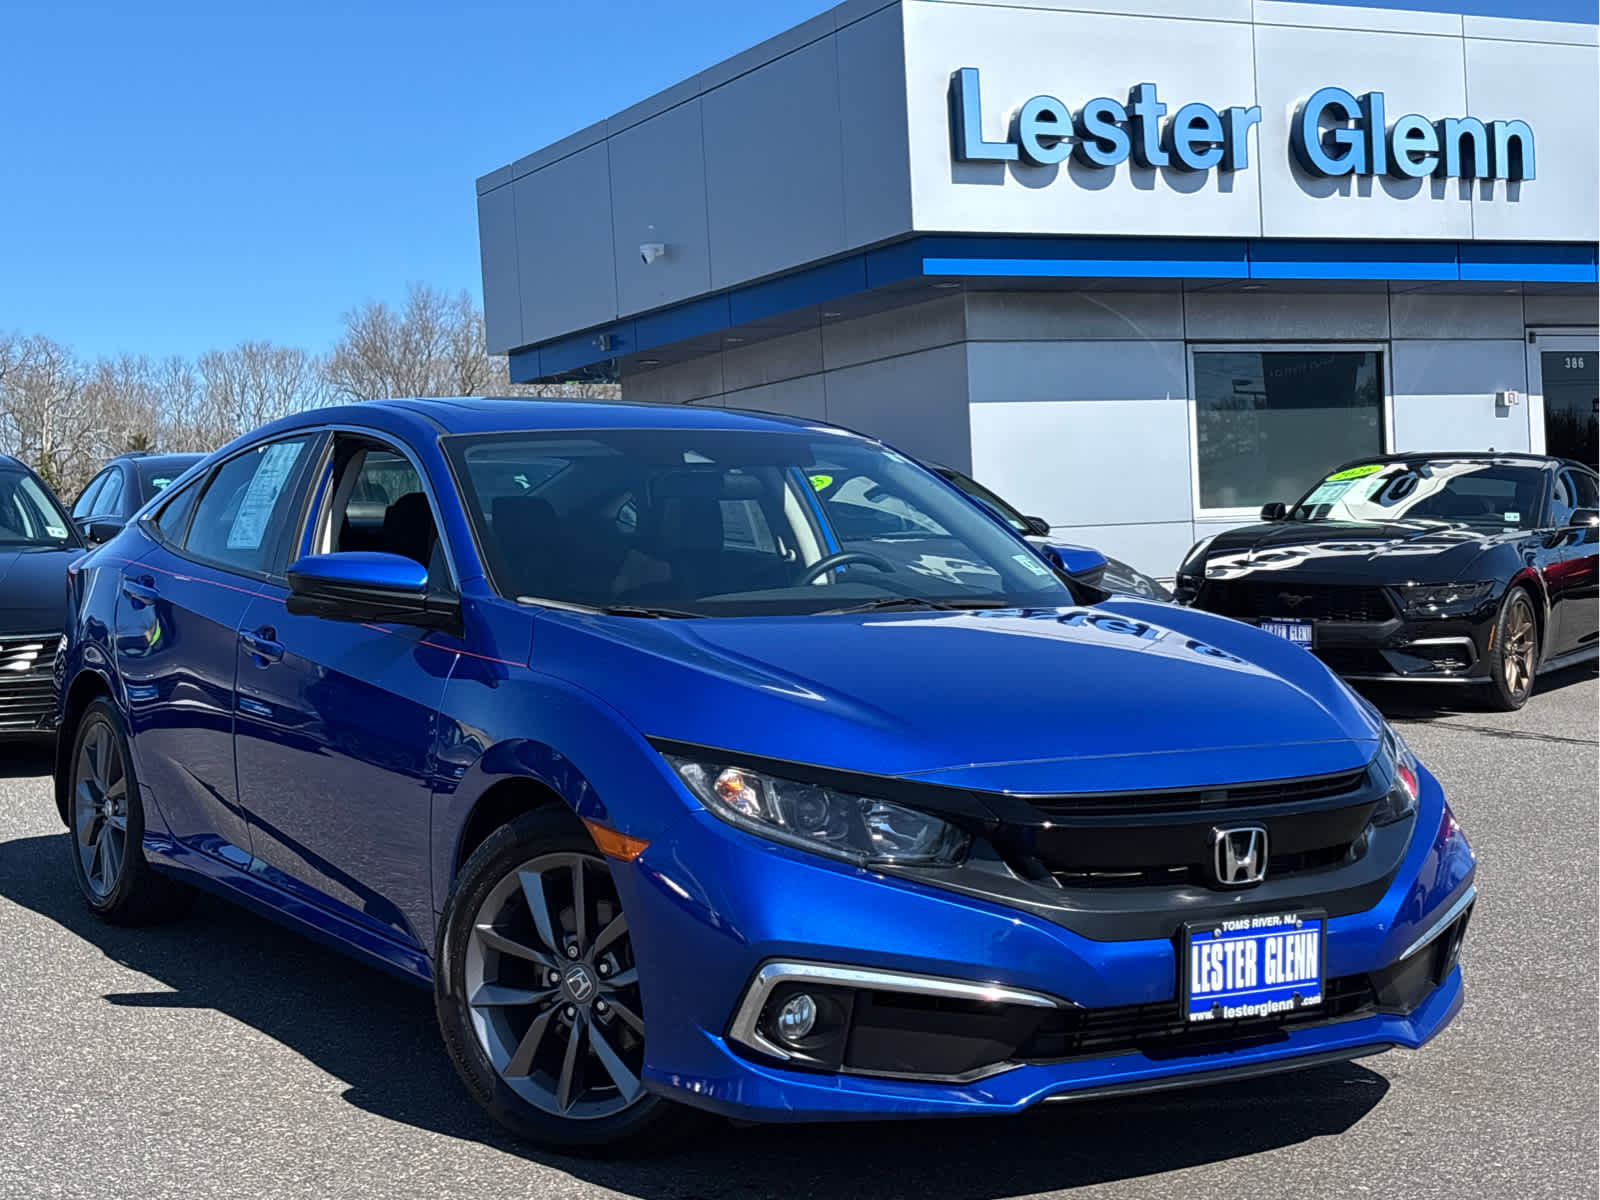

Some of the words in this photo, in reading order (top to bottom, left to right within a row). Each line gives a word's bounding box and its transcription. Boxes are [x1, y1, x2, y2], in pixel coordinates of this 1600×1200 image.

[949, 66, 1262, 171] Lester
[1288, 86, 1536, 183] Glenn
[1564, 357, 1584, 369] 386
[1222, 919, 1250, 931] TOMS
[1191, 940, 1257, 993] LESTER
[1265, 932, 1319, 985] GLENN
[1223, 999, 1294, 1018] lesterglenn
